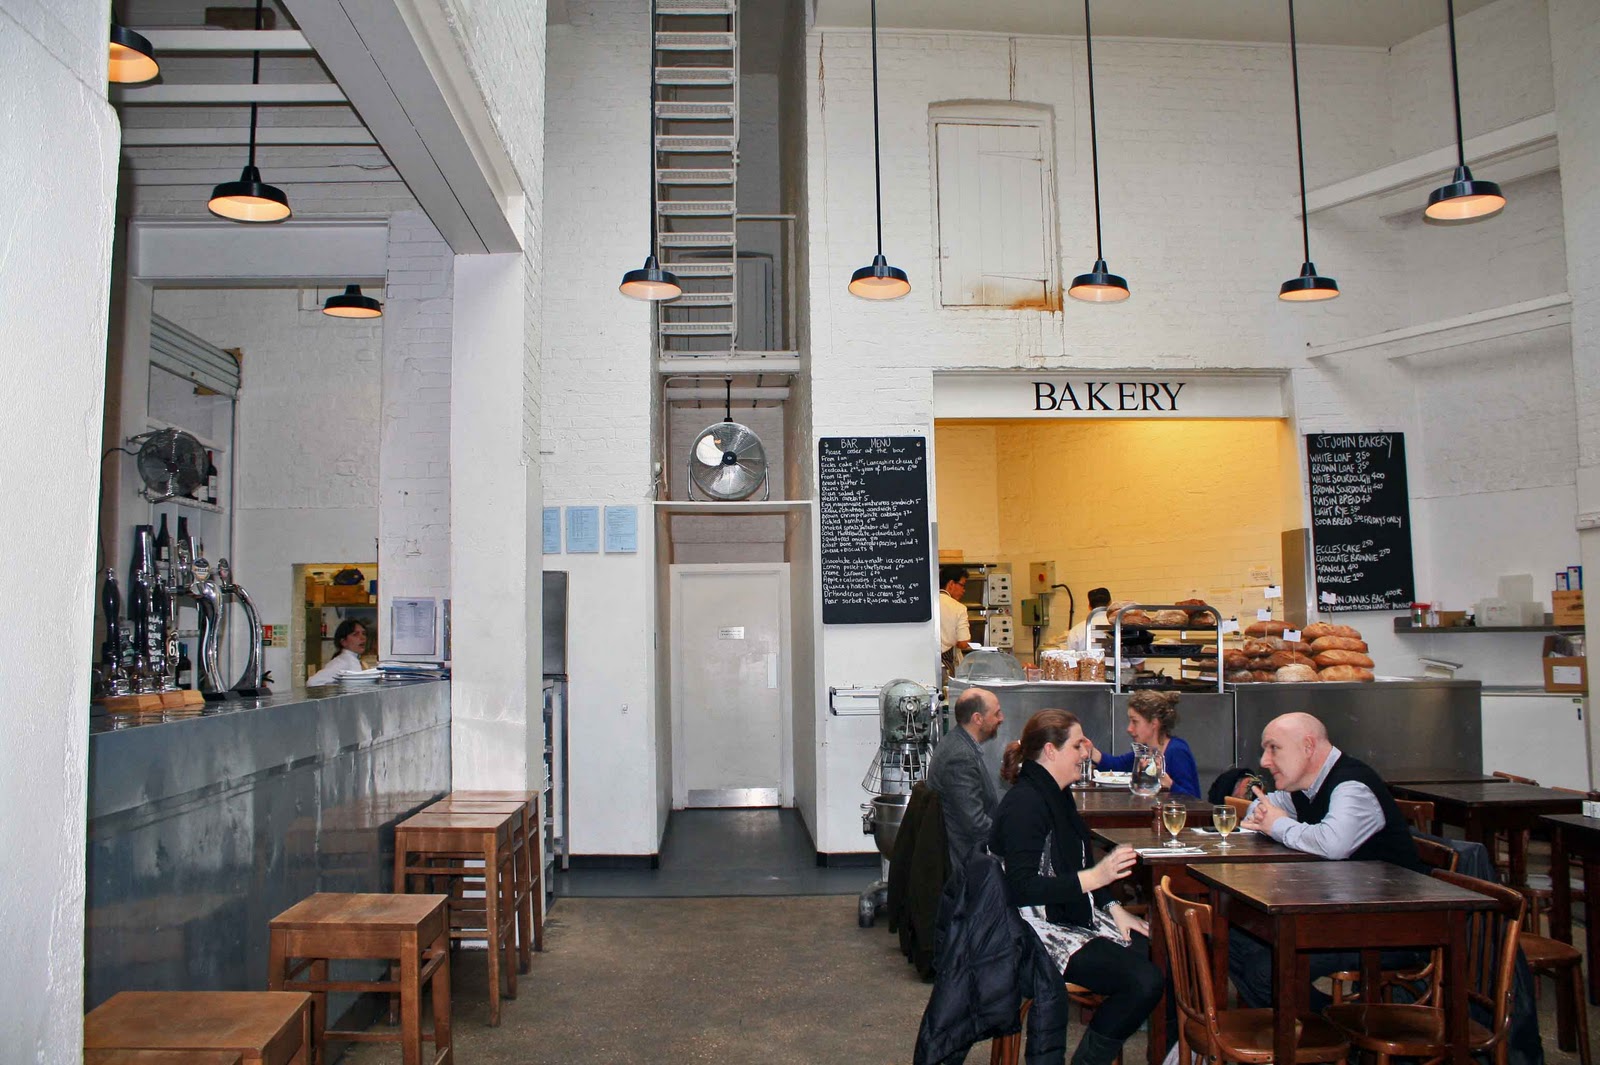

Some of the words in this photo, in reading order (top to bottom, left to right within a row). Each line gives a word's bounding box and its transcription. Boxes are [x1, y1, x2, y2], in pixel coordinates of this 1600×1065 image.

[1032, 382, 1187, 411] BAKERY
[841, 439, 858, 448] BAR
[871, 438, 891, 447] MENU
[1331, 436, 1356, 448] JOHN
[1359, 435, 1392, 459] BAKERY
[1310, 453, 1332, 462] WHITE
[1334, 453, 1352, 462] LOAF
[1312, 464, 1336, 474] BROWN
[1338, 464, 1354, 472] LOAF
[1312, 474, 1330, 484] WHITE
[1332, 474, 1371, 484] SOURDOUGH
[1313, 485, 1335, 495] BROWN
[1336, 485, 1372, 494] SOURDOUGH
[1314, 496, 1337, 506] RAISIN
[1339, 494, 1360, 504] BREAD
[1314, 507, 1333, 516] LIGHT
[1335, 506, 1349, 518] RYE
[1315, 518, 1332, 526] SODA
[1364, 516, 1386, 526] FRIDAYS
[1387, 516, 1401, 528] ONLY
[1316, 545, 1340, 554] ECCLES
[1342, 544, 1361, 553] CAKE
[1316, 554, 1349, 563] CHOCOLATE
[1351, 554, 1379, 562] BROWNIE
[1316, 565, 1346, 574] GRANOLA
[1317, 575, 1352, 583] MERINGUE
[1345, 595, 1370, 603] CANVAS
[1372, 594, 1385, 603] BAG
